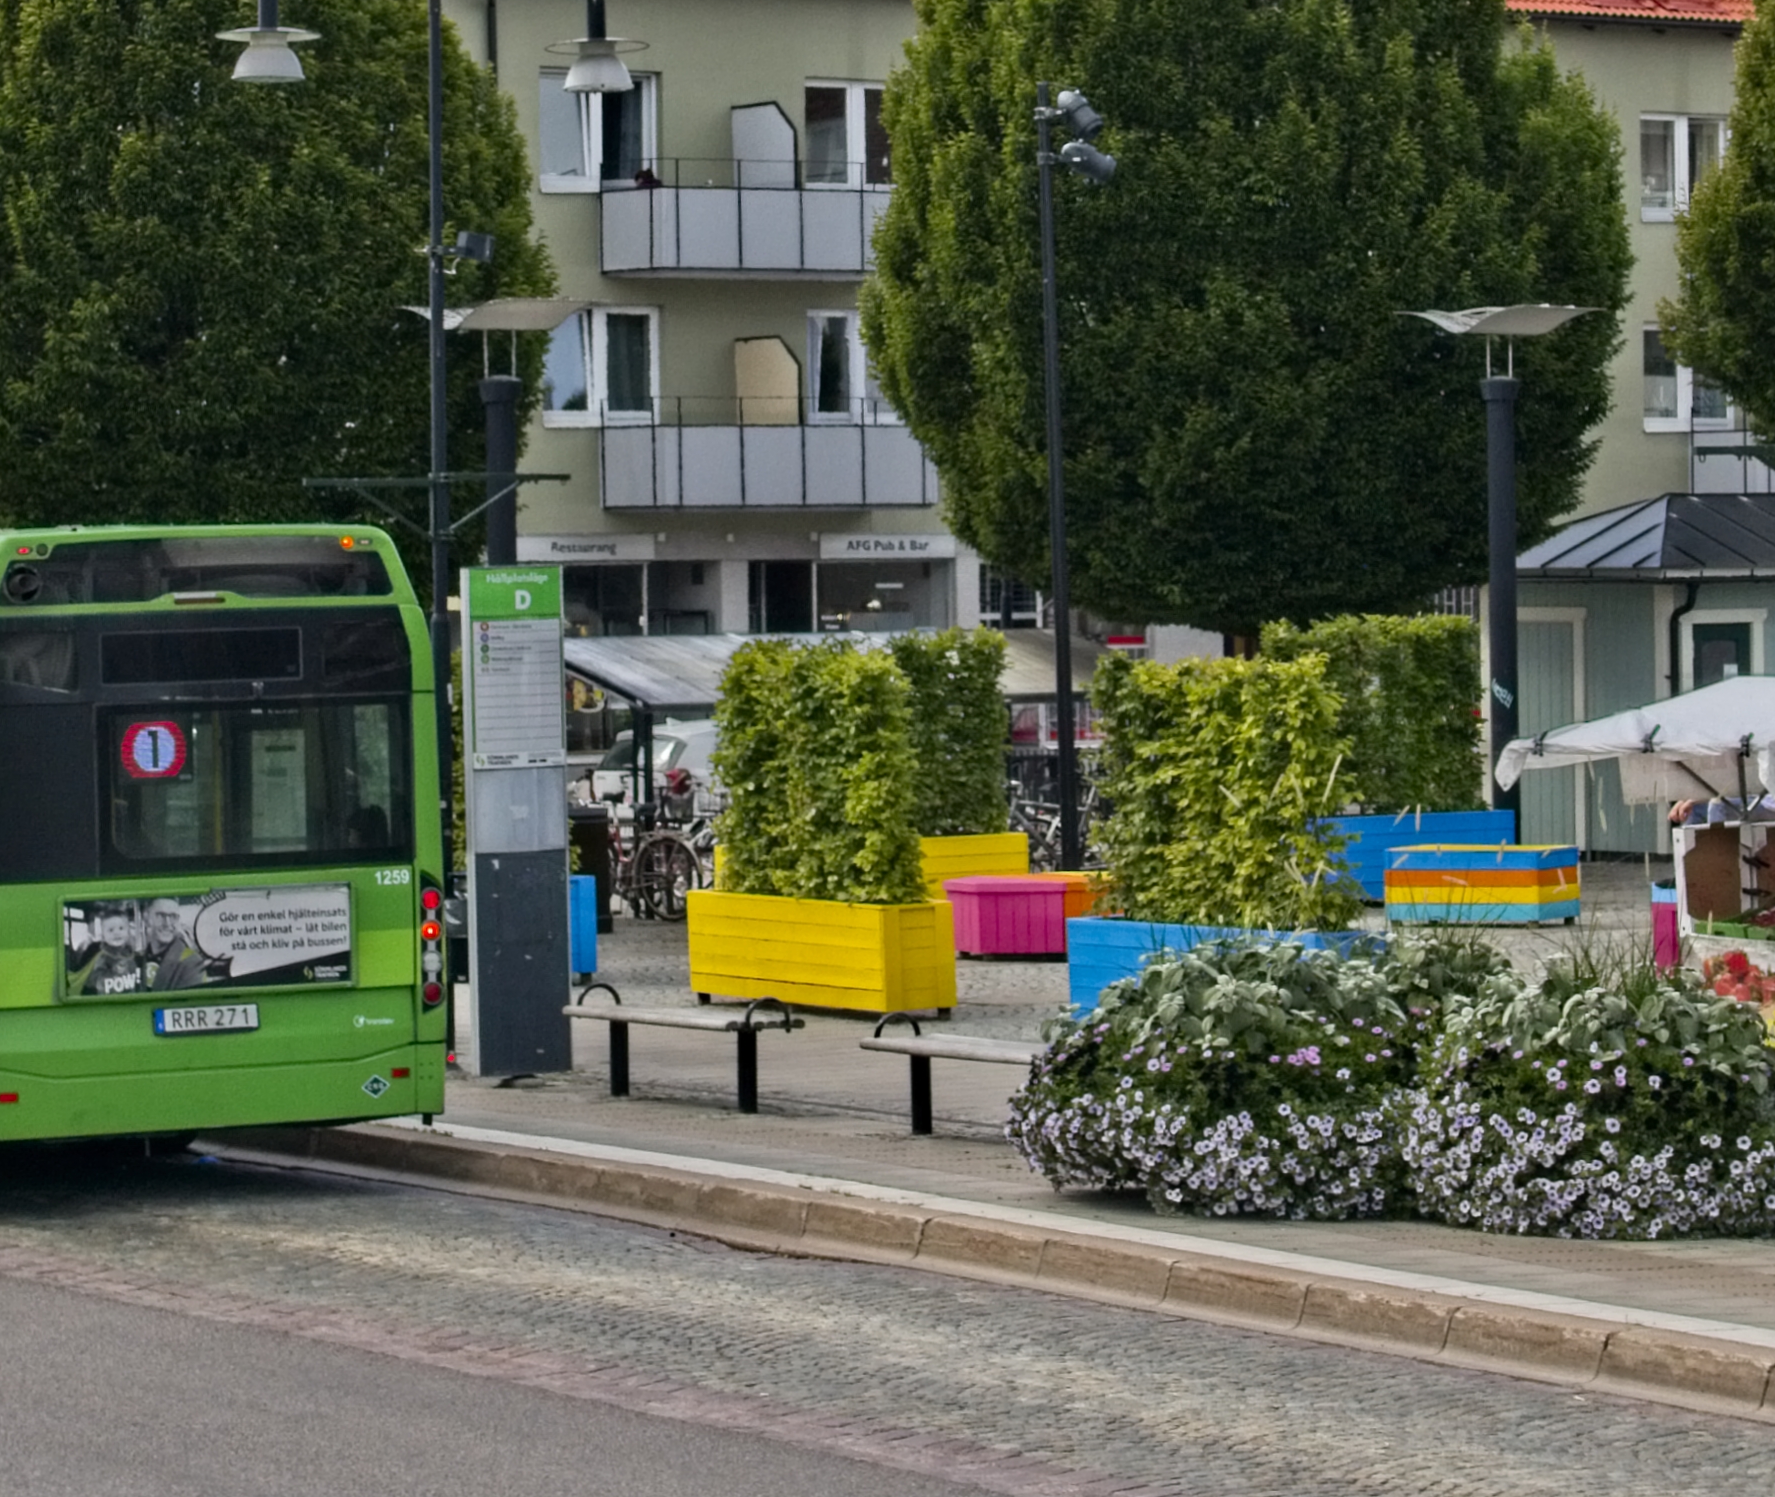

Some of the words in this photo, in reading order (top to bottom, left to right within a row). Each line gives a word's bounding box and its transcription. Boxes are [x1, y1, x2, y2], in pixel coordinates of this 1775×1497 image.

[874, 539, 895, 551] Pub
[898, 539, 906, 551] &
[909, 539, 929, 551] Bar
[515, 589, 532, 610] D
[147, 730, 159, 768] 1
[374, 869, 410, 885] 1259
[218, 911, 239, 923] Gör
[241, 912, 255, 921] en
[257, 909, 286, 921] enkel
[288, 907, 347, 921] hjälteinsats
[219, 926, 234, 937] för
[237, 924, 258, 936] vårt
[260, 923, 292, 935] klimat
[305, 922, 318, 933] låt
[321, 921, 347, 933] bilen
[231, 939, 247, 951] stå
[249, 938, 269, 950] och
[271, 937, 289, 949] kliv
[292, 936, 305, 950] på
[307, 935, 347, 948] bussen!
[104, 967, 141, 994] POW!
[171, 1009, 209, 1029] RRR
[214, 1007, 250, 1026] 271
